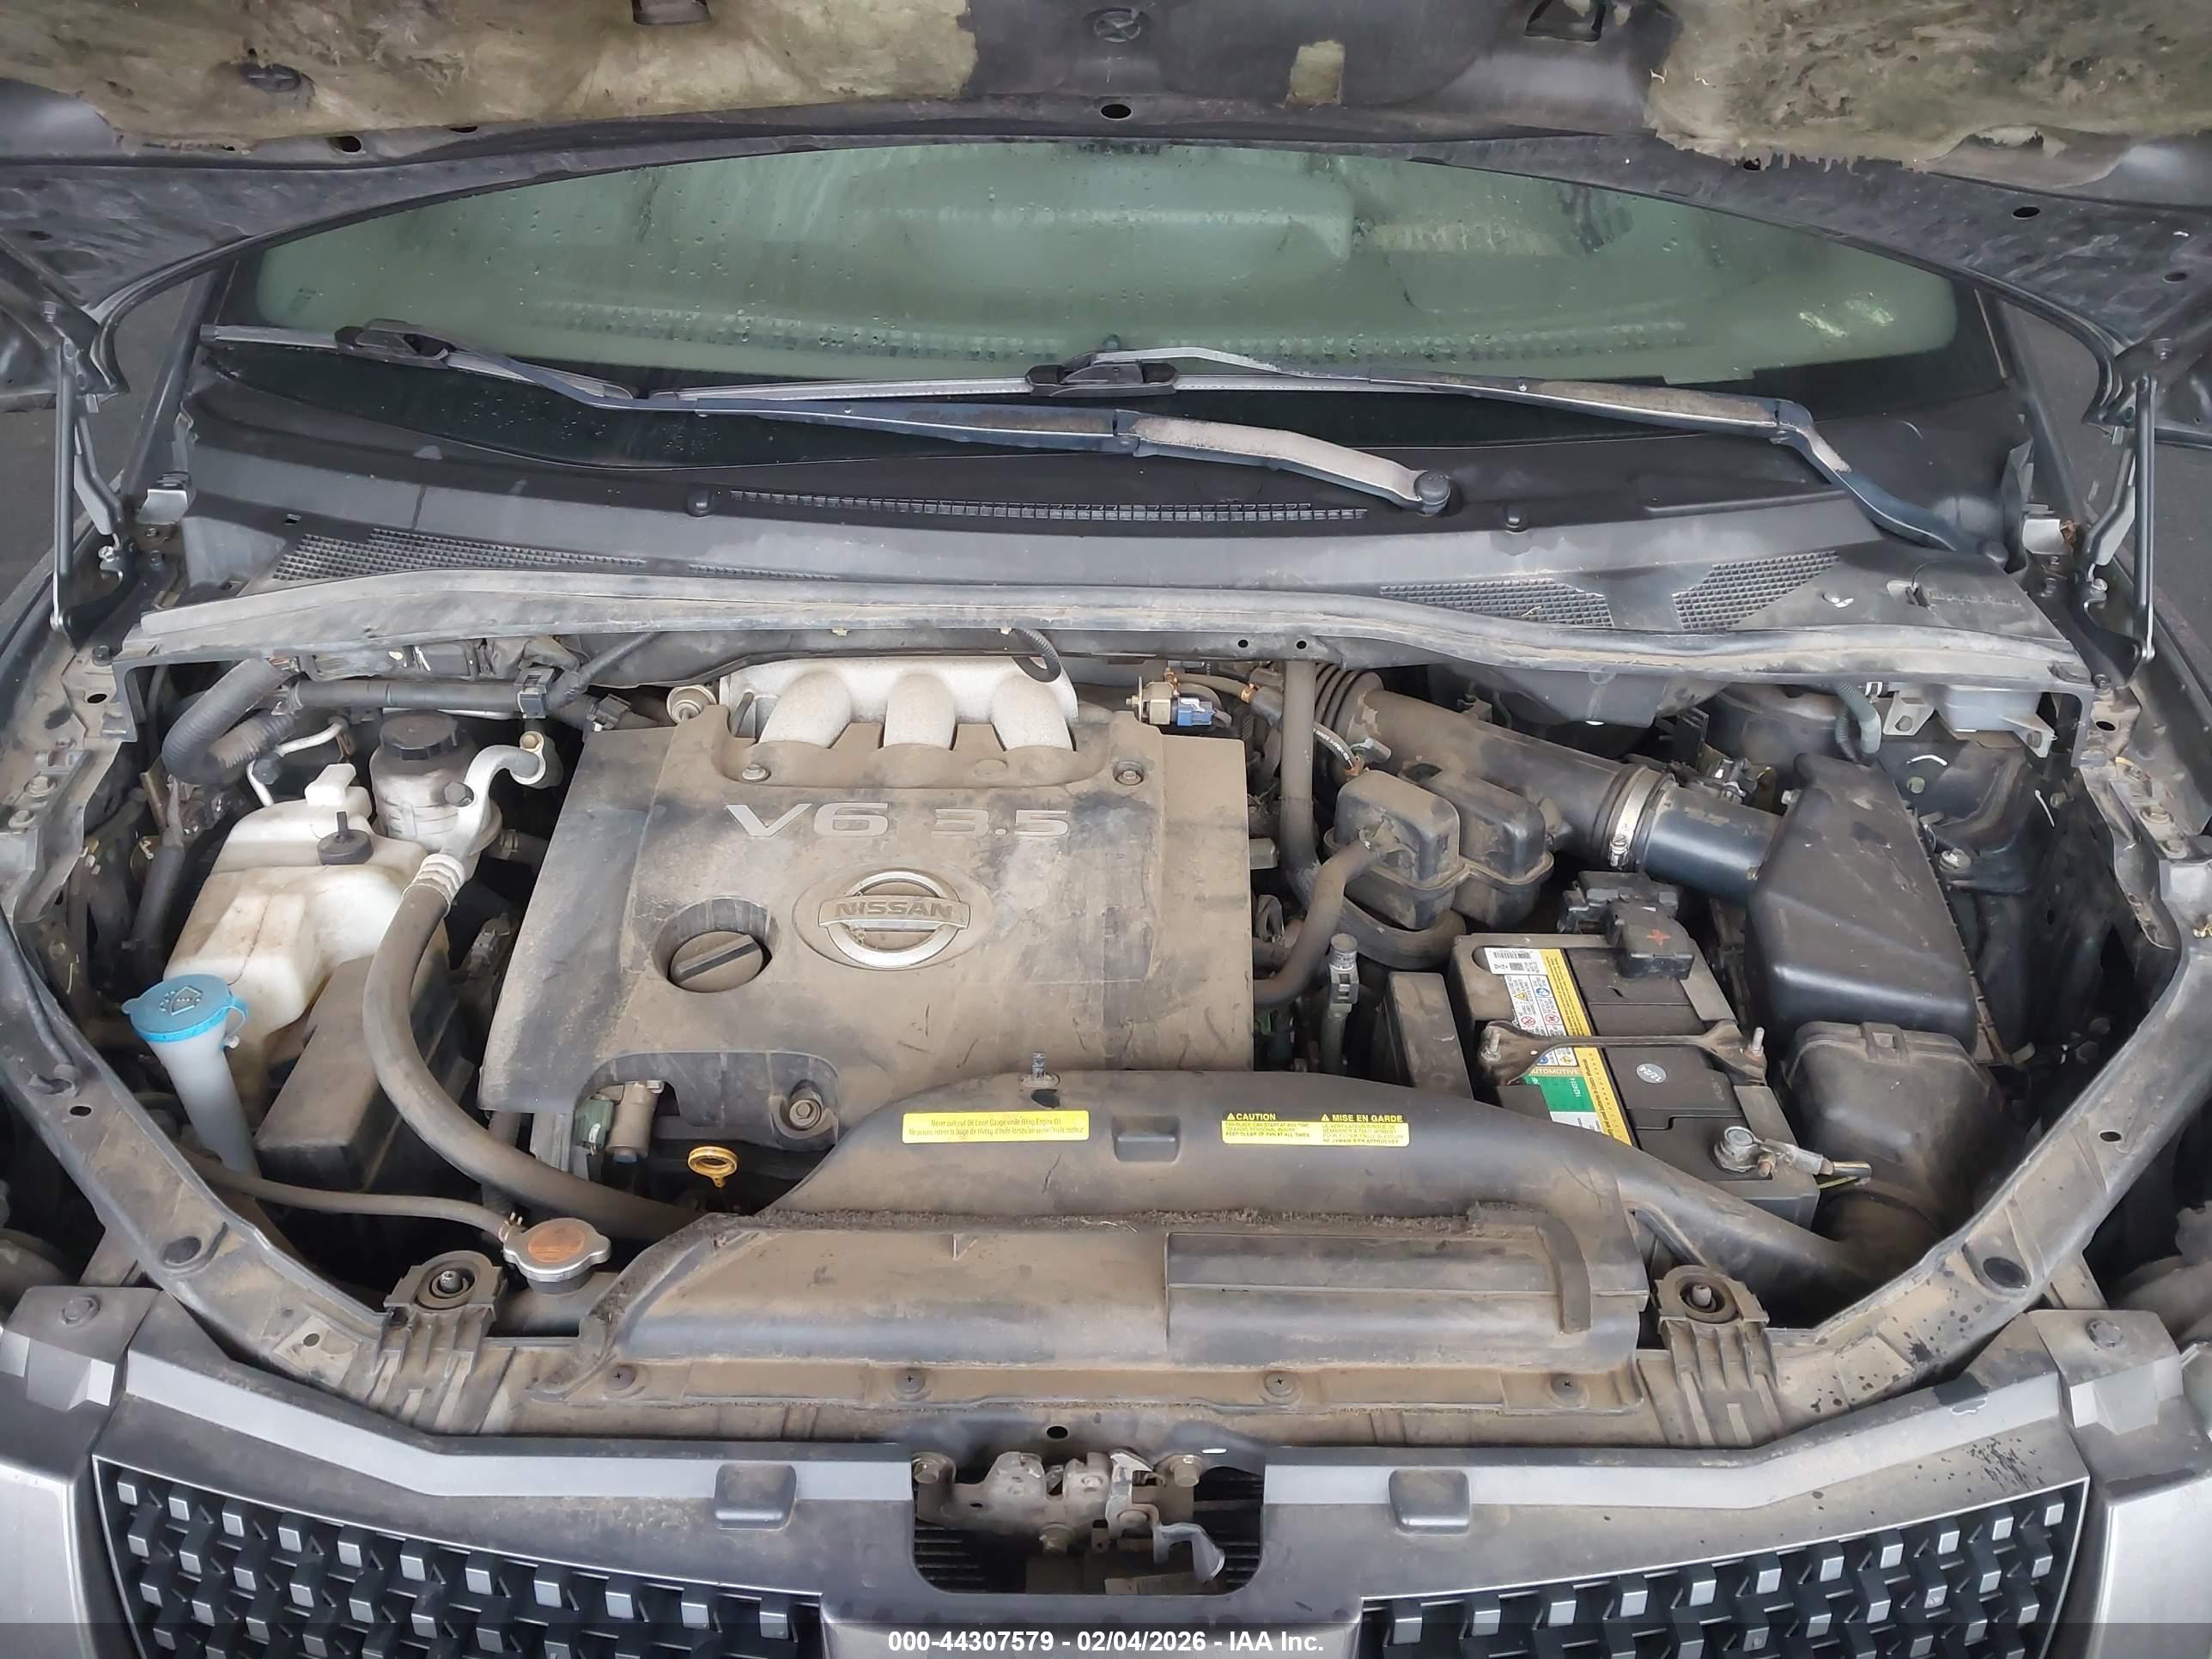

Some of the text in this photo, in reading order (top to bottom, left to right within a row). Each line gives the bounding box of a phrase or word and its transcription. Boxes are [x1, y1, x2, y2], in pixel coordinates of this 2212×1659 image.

[726, 801, 1069, 839] V6 3.5
[836, 901, 953, 918] NISSAN
